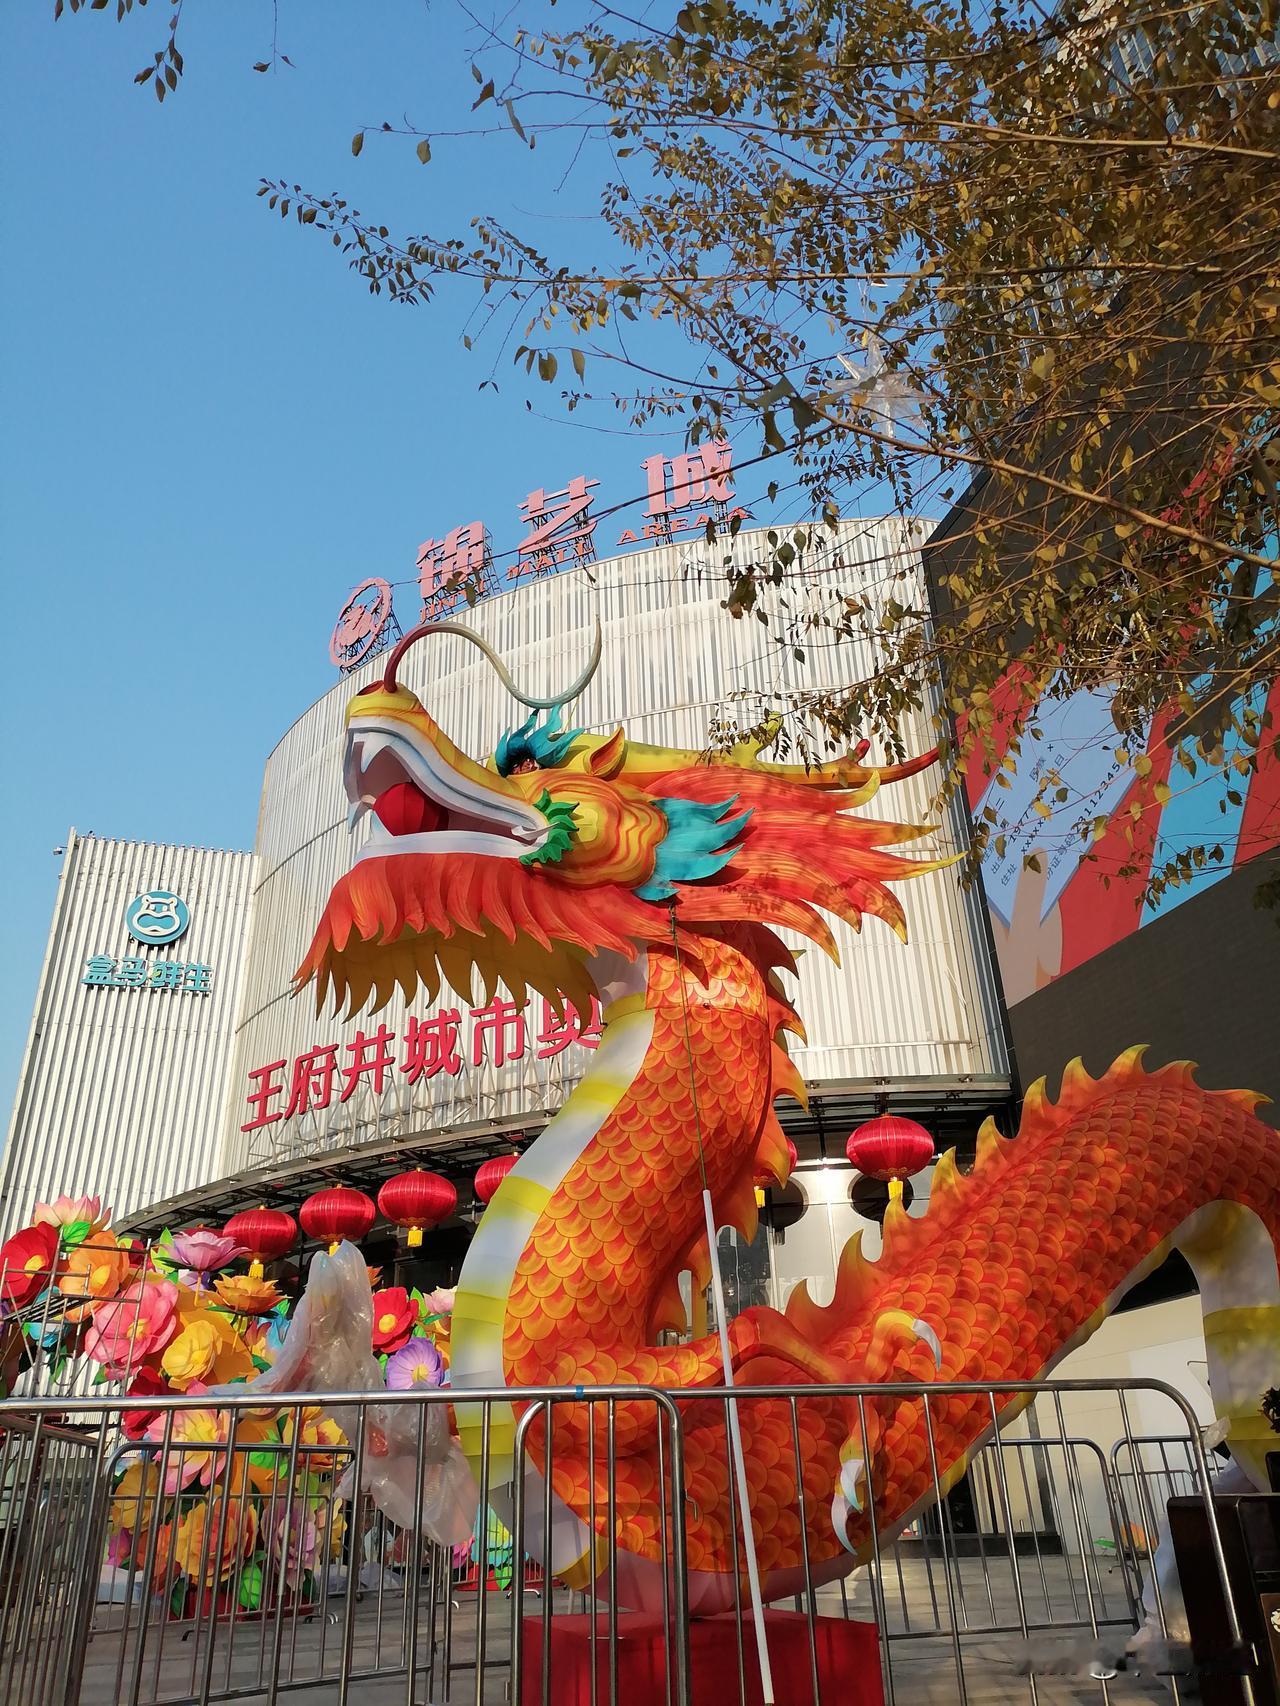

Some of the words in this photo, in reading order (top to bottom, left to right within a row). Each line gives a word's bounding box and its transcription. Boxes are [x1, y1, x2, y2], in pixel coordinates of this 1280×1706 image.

[416, 440, 737, 599] 锦艺城
[507, 541, 595, 581] MALL
[616, 513, 711, 546] AREA
[80, 954, 213, 992] 盒马鲜生
